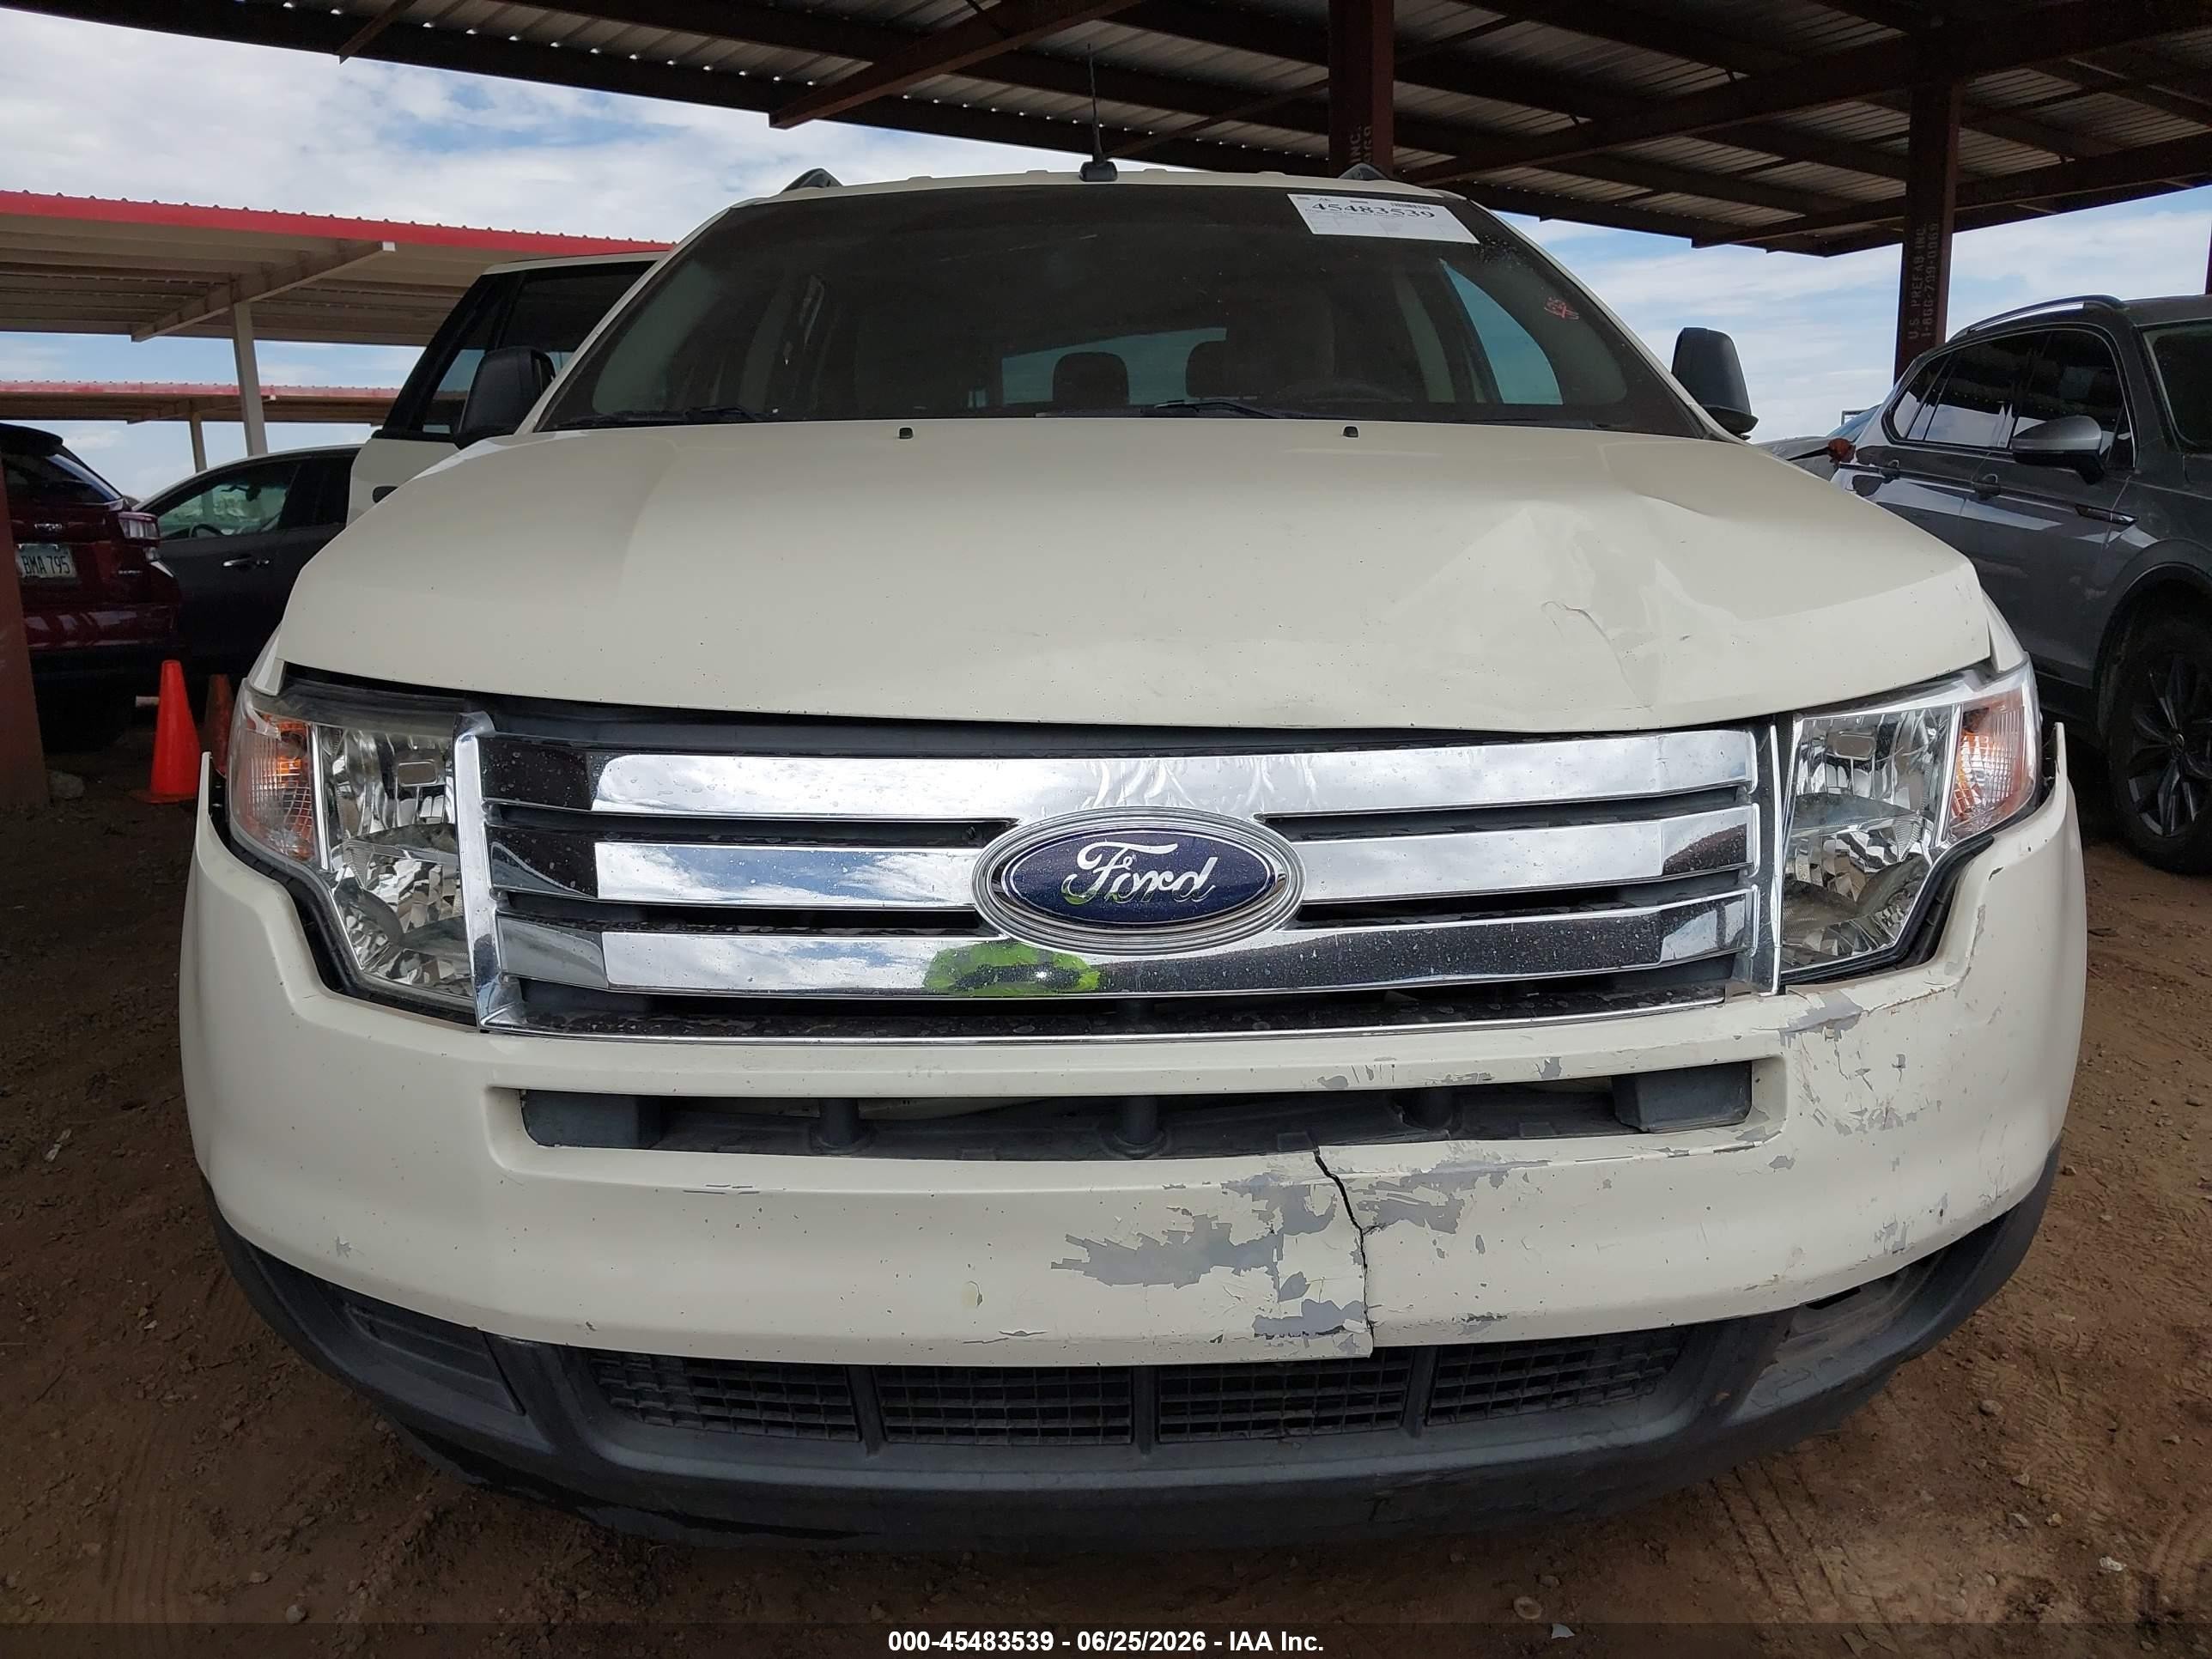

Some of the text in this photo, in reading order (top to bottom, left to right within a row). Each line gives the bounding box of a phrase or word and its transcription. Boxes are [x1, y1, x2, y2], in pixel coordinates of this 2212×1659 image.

[1312, 203, 1435, 218] 45483539
[1911, 256, 1924, 307] PREFAB
[21, 556, 70, 574] BMA 795
[1061, 841, 1218, 904] Ford
